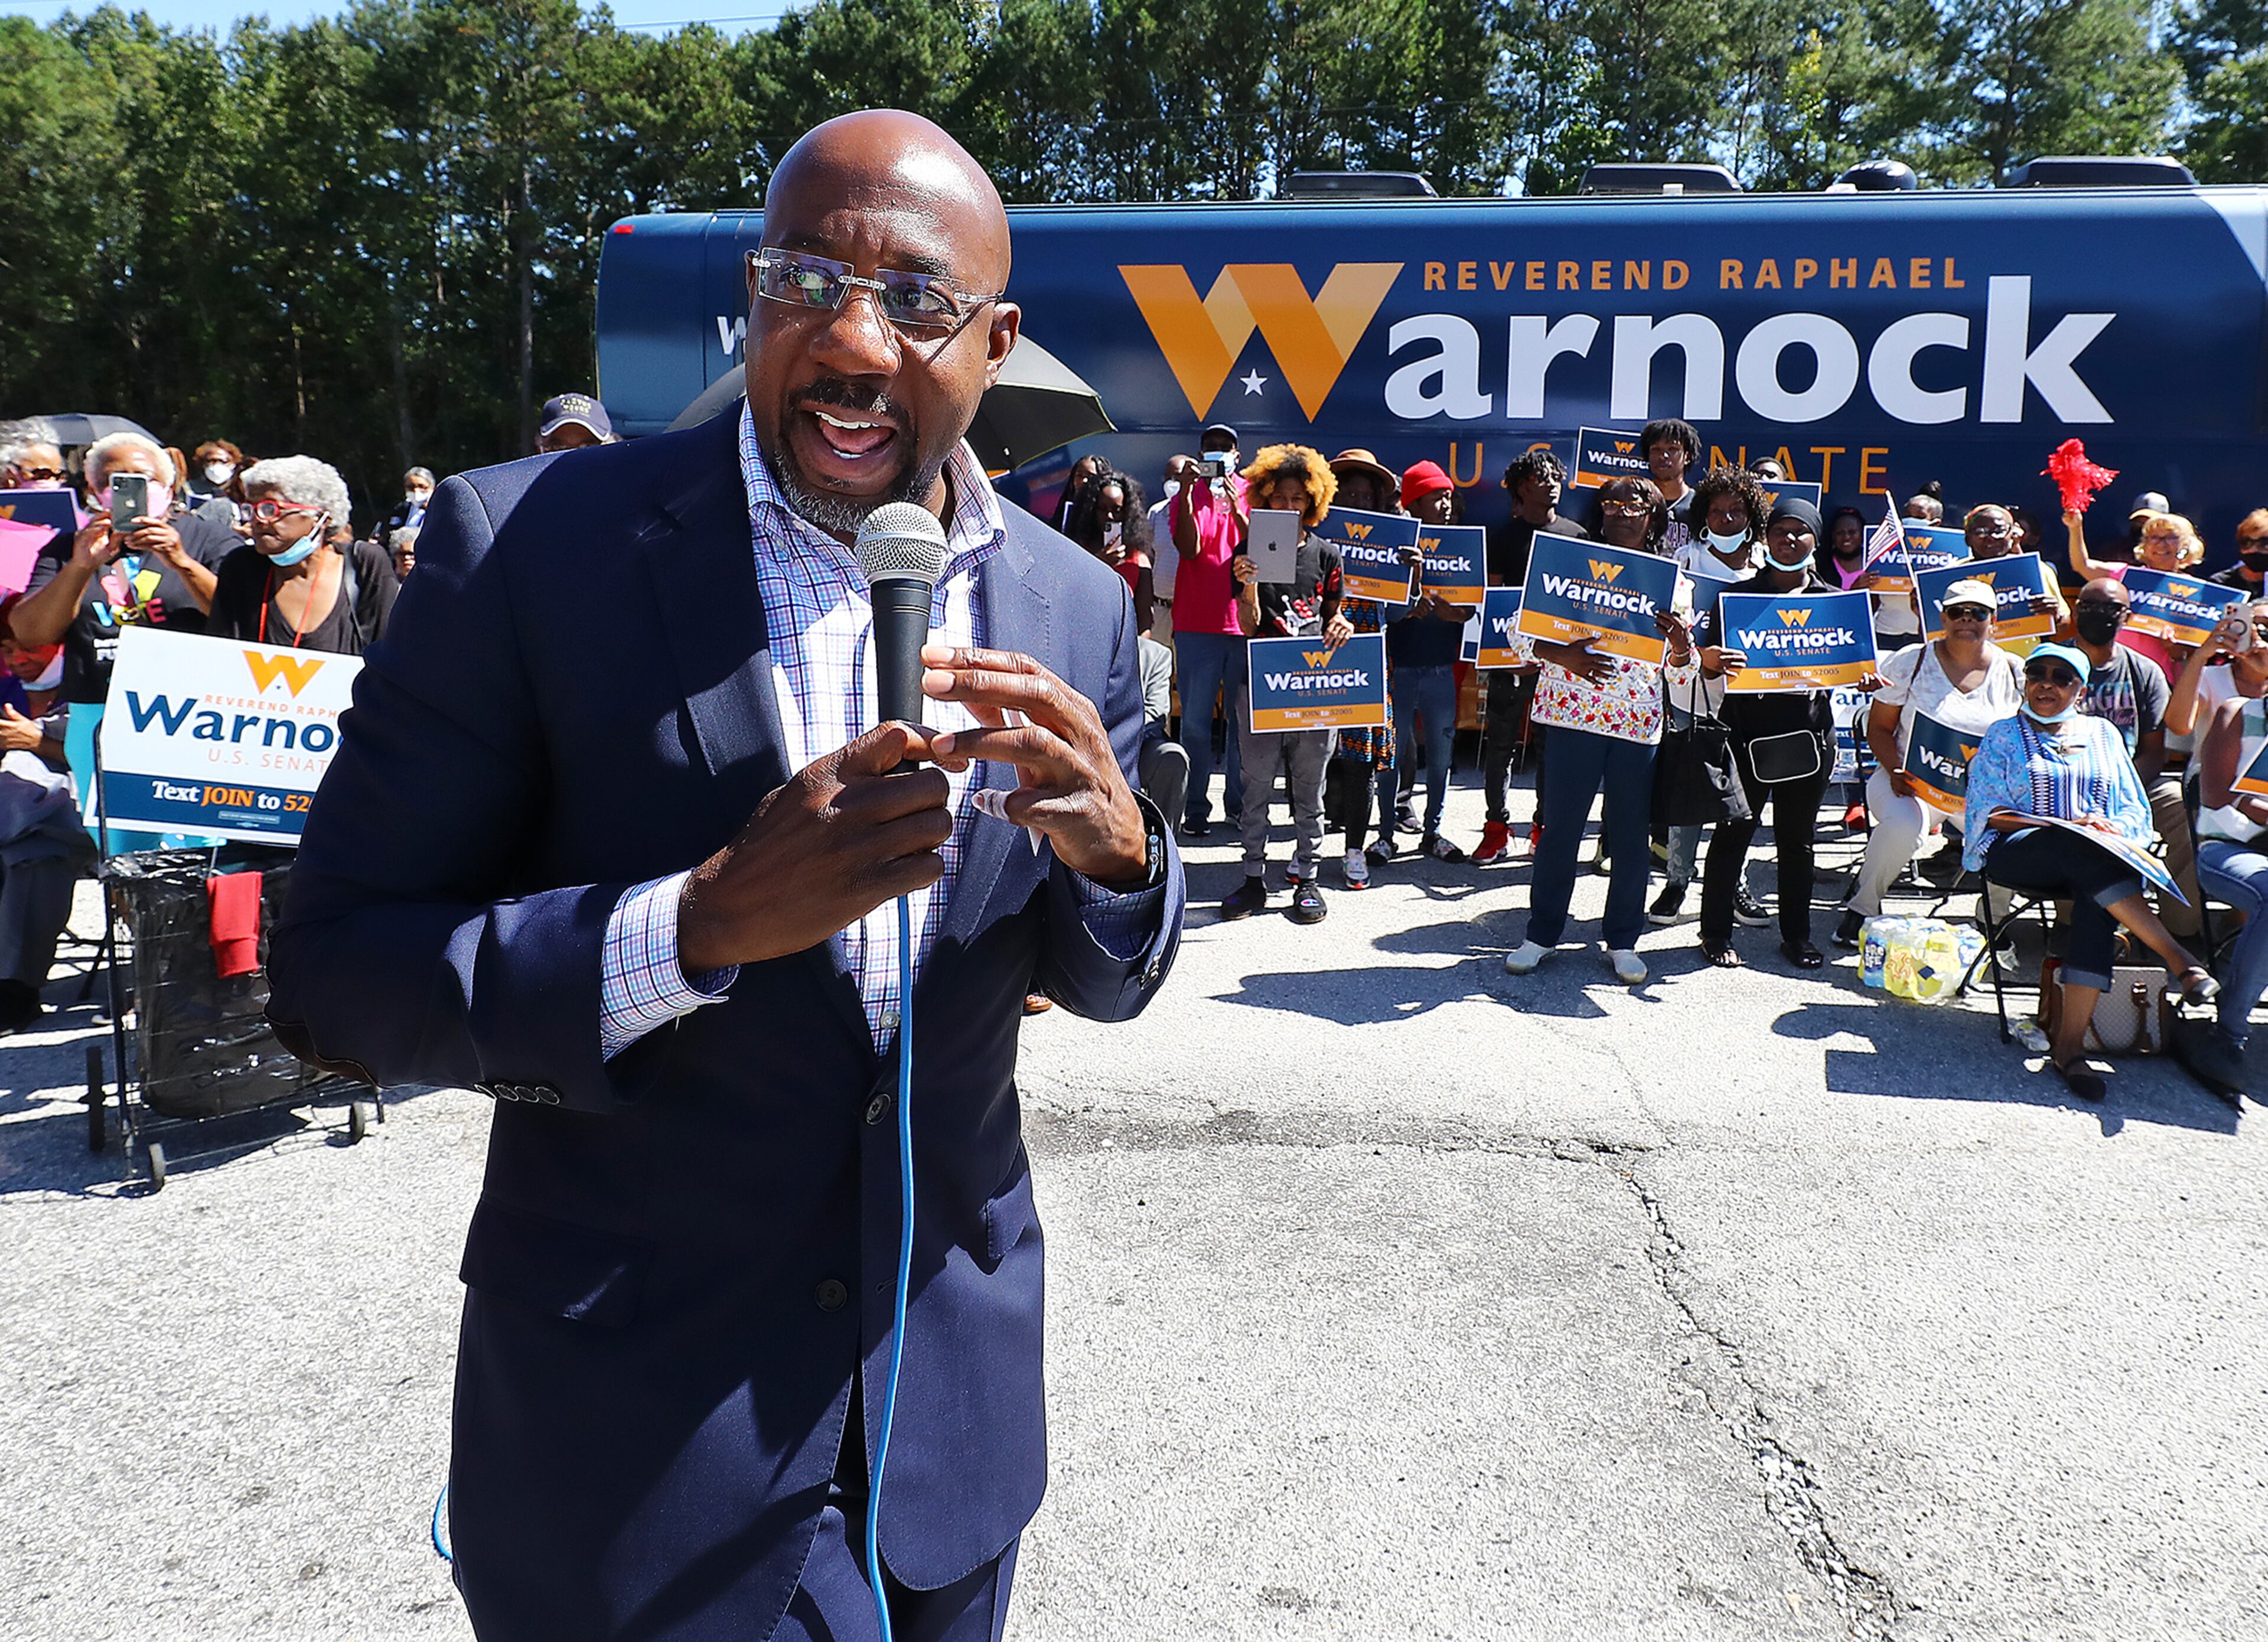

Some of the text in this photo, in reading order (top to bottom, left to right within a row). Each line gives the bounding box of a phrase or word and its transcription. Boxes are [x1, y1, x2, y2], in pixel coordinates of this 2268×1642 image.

[1423, 258, 1965, 291] REVEREND RAPHAEL
[1117, 263, 2117, 424] Warnock
[1709, 445, 1889, 494] NATE
[1542, 573, 1655, 616] Warnock
[2129, 589, 2222, 621] Warnock
[1594, 605, 1629, 620] SENATE
[1553, 620, 1570, 631] Text
[1570, 624, 1590, 636] JOIN
[1738, 627, 1856, 650] Warnock
[1796, 647, 1831, 656] SENATE
[1264, 669, 1369, 691] Warnock
[1760, 671, 1779, 679] Text
[1780, 670, 1800, 678] JOIN
[205, 695, 337, 718] REVEREND RAPH
[125, 690, 344, 752] Warno
[208, 748, 328, 773] U.S. SENAT
[151, 780, 200, 803] Text
[201, 786, 255, 807] JOIN
[258, 793, 281, 810] to
